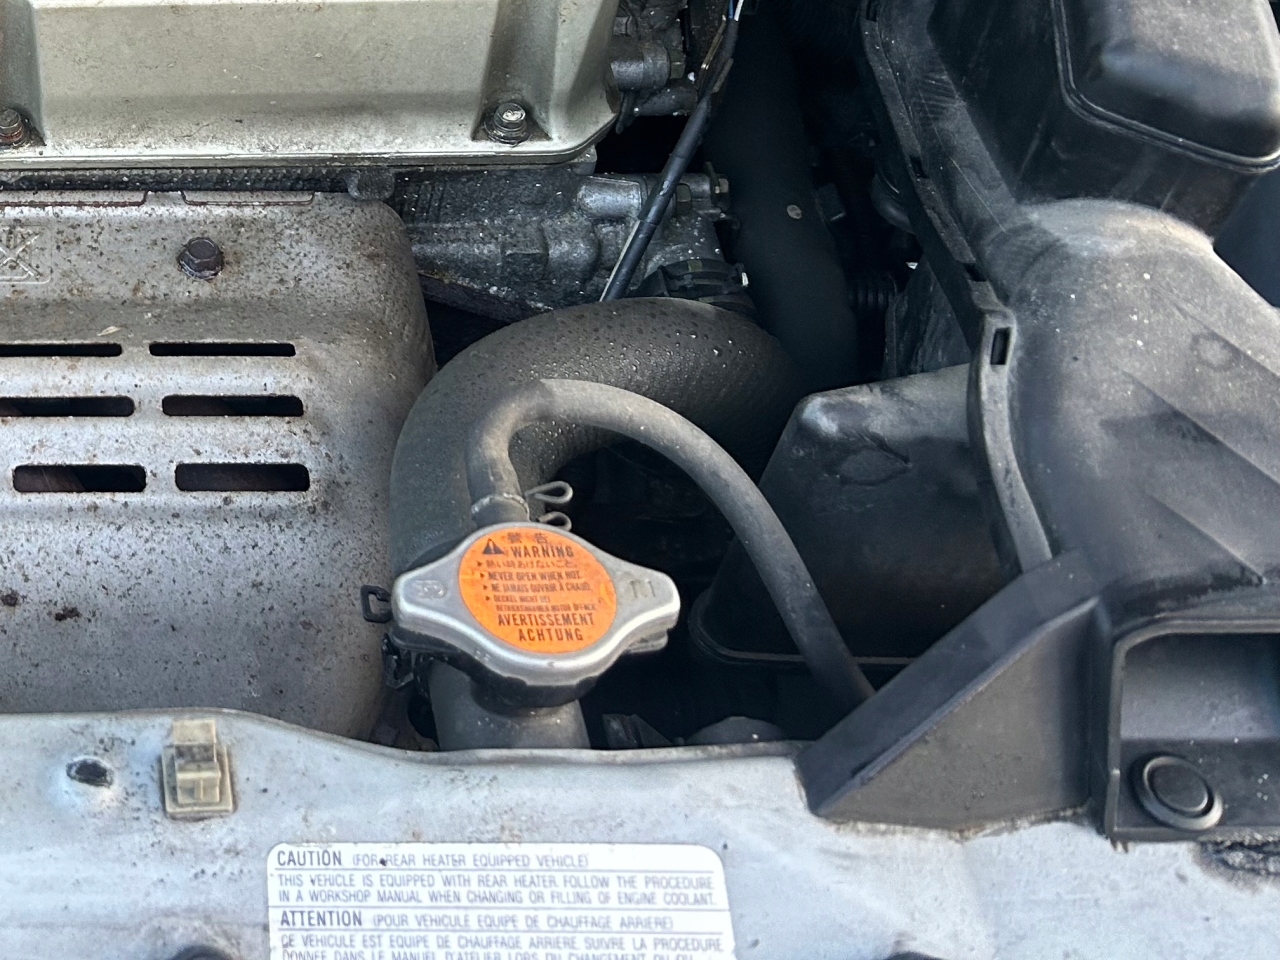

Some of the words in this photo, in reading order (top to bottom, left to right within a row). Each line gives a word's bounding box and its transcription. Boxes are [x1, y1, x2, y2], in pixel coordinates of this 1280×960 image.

[510, 544, 574, 558] WARNING
[488, 571, 513, 581] NEVER
[516, 571, 537, 581] OPEN
[539, 571, 563, 581] WHEN
[498, 612, 594, 627] AVERTISSEMENT
[518, 627, 584, 642] ACHTUNG
[277, 850, 342, 867] CAUTION
[352, 853, 380, 867] (FOR
[385, 853, 417, 867] REAR
[422, 853, 467, 867] HEATER
[473, 853, 530, 868] EQUIPPED
[536, 854, 589, 868] VEHICLE)
[278, 873, 304, 887] THIS
[310, 873, 356, 887] VEHICLE
[362, 873, 374, 887] IS
[379, 873, 435, 888] EQUIPPED
[441, 873, 471, 888] WITH
[477, 874, 507, 888] REAR
[563, 874, 610, 889] FOLLOW
[616, 875, 638, 889] THE
[644, 876, 715, 891] PROCEDURE
[279, 889, 290, 902] IN
[295, 889, 304, 902] A
[309, 889, 371, 903] WORKSHOP
[377, 890, 423, 903] MANUAL
[428, 890, 461, 903] WHEN
[466, 890, 523, 904] CHANGING
[528, 890, 545, 904] OR
[550, 891, 591, 905] FILLING
[597, 891, 611, 904] OF
[617, 892, 658, 906] ENGINE
[280, 910, 363, 927] ATTENTION
[373, 914, 409, 928] (POUR
[415, 914, 470, 928] VEHICULE
[477, 914, 518, 929] EQUIPE
[525, 914, 540, 929] DE
[547, 915, 613, 929] CHAUFFAGE
[281, 934, 294, 949] CE
[301, 934, 356, 949] VEHICULE
[362, 934, 383, 948] EST
[389, 934, 430, 949] EQUIPE
[436, 935, 452, 949] DE
[457, 935, 522, 949] CHAUFFAGE
[584, 936, 625, 951] SUIVRE
[633, 937, 648, 950] LA
[653, 937, 724, 952] PROCEDURE
